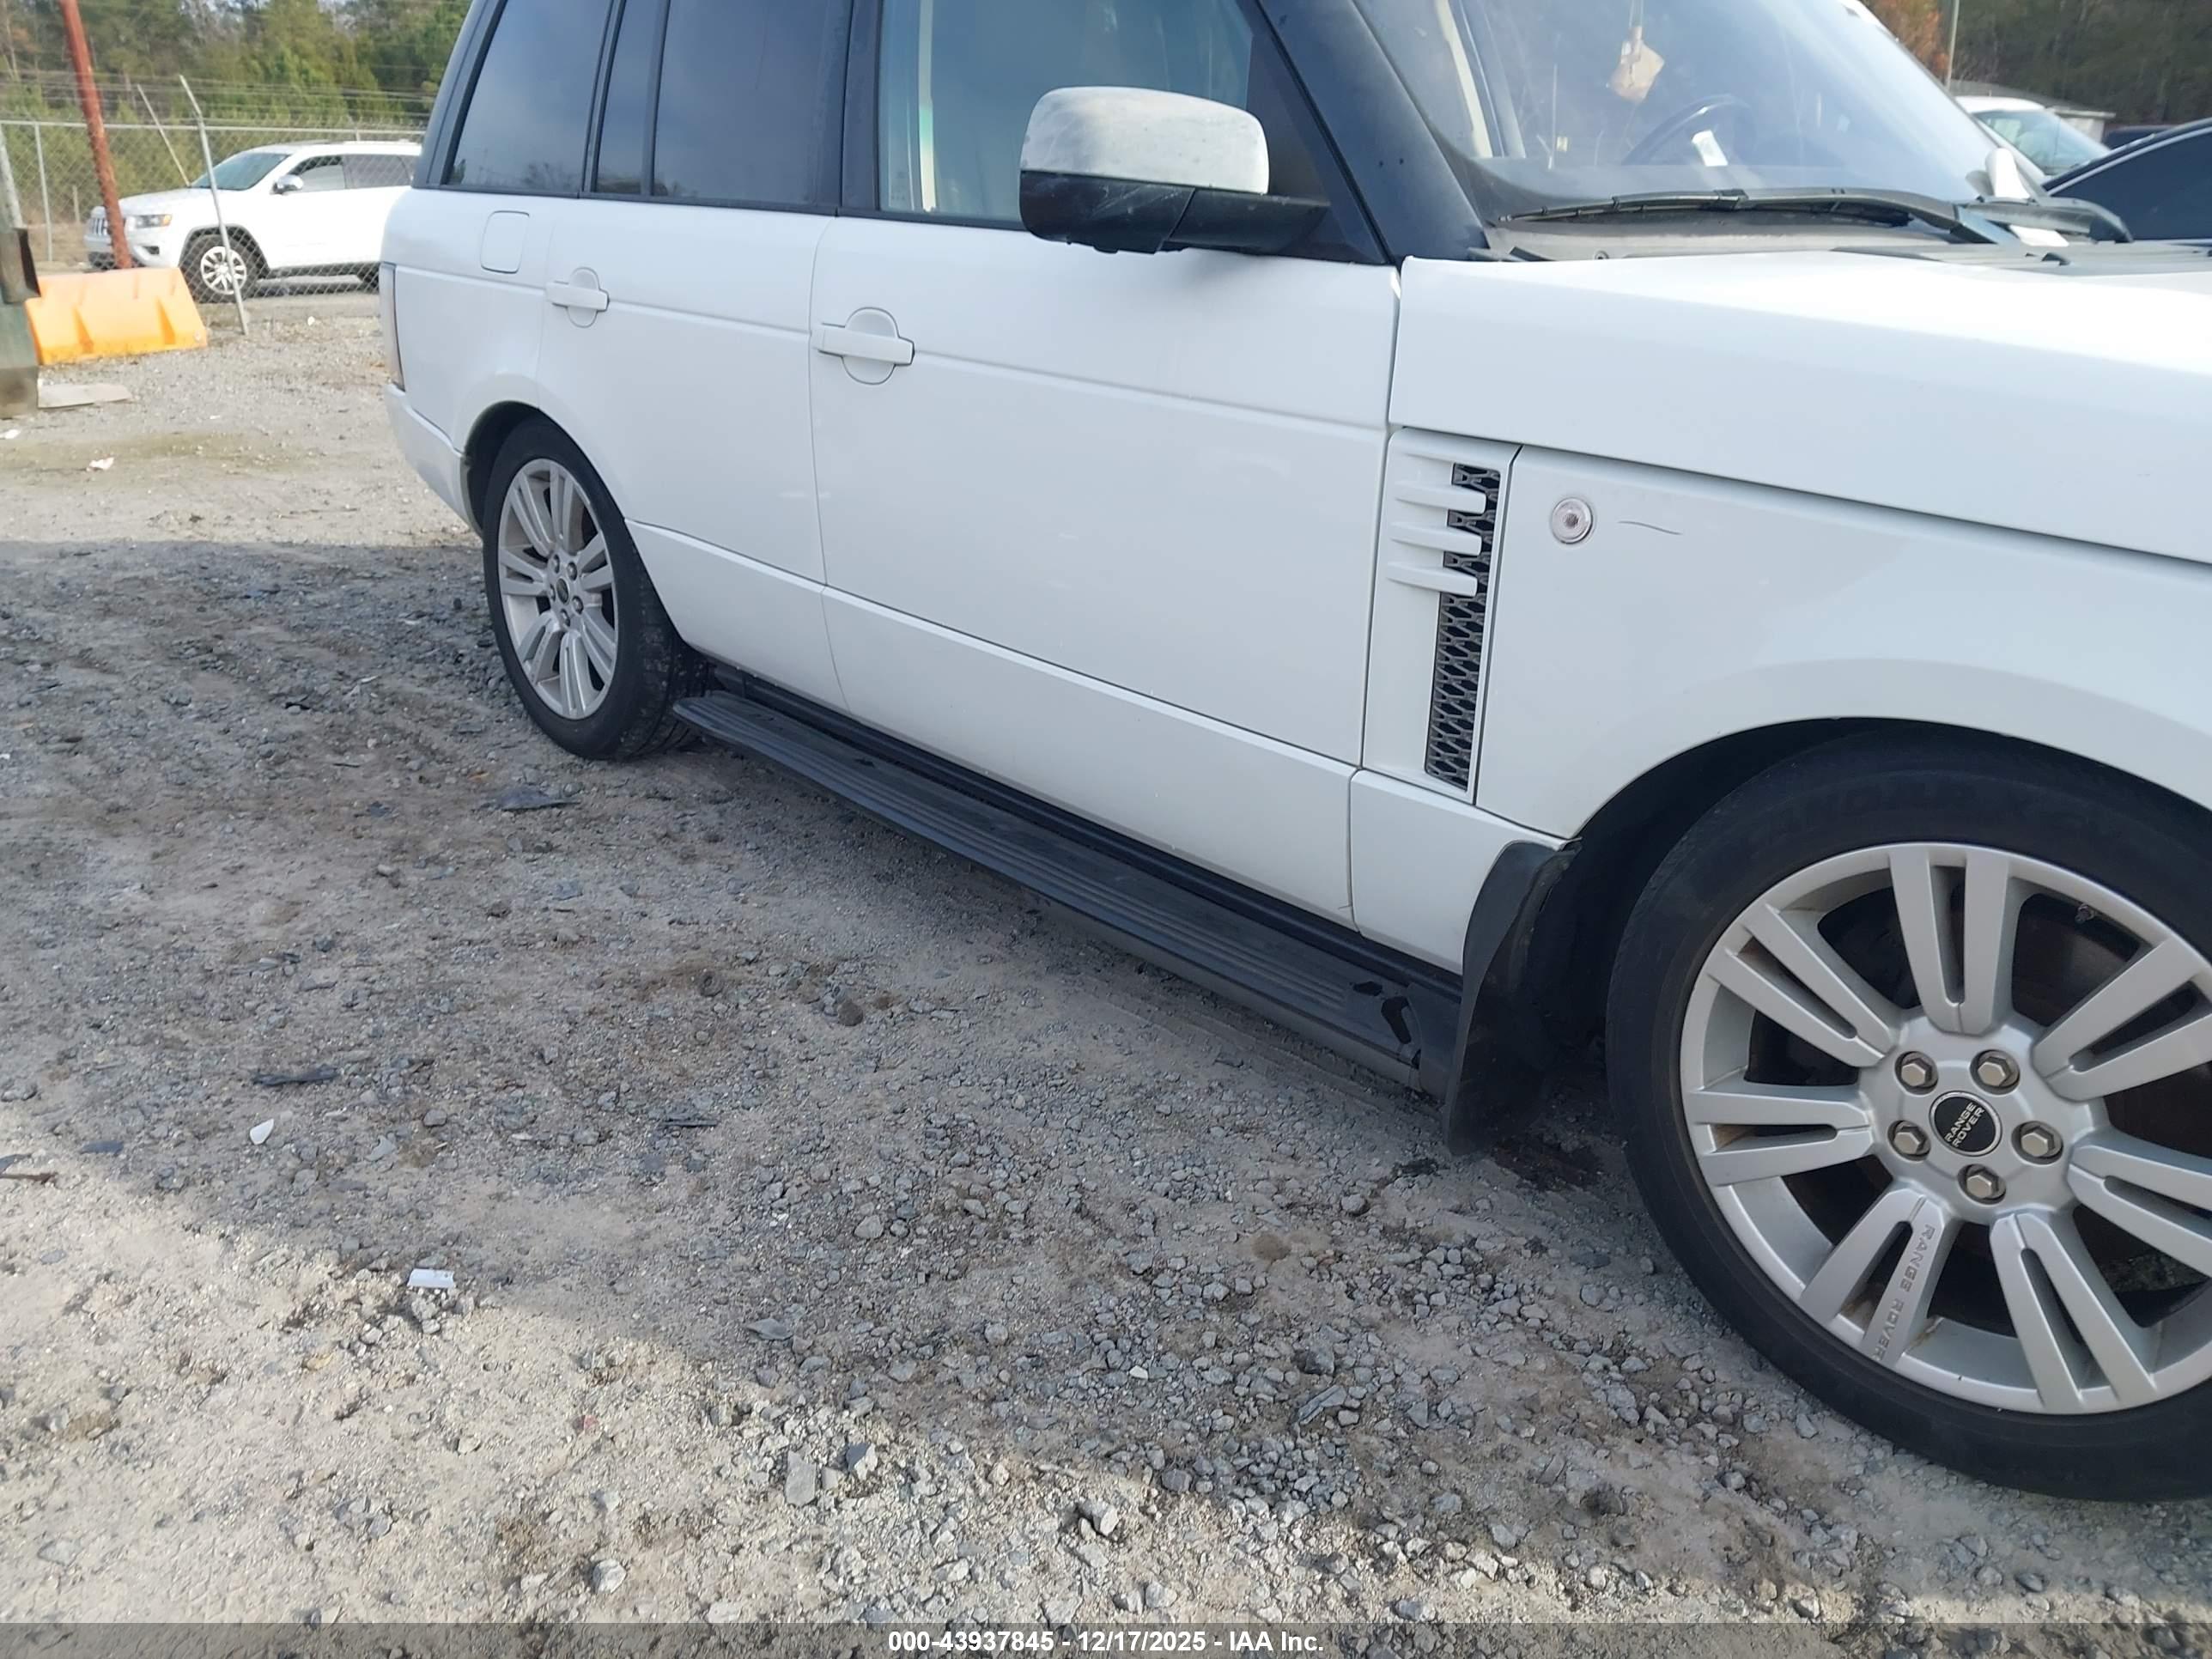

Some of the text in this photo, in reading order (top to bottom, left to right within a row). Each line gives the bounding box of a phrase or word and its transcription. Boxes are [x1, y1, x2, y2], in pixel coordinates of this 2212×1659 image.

[1944, 1102, 1977, 1143] RANGE
[1951, 1106, 1985, 1148] ROVER
[1872, 1224, 1936, 1361] RANGE ROVER
